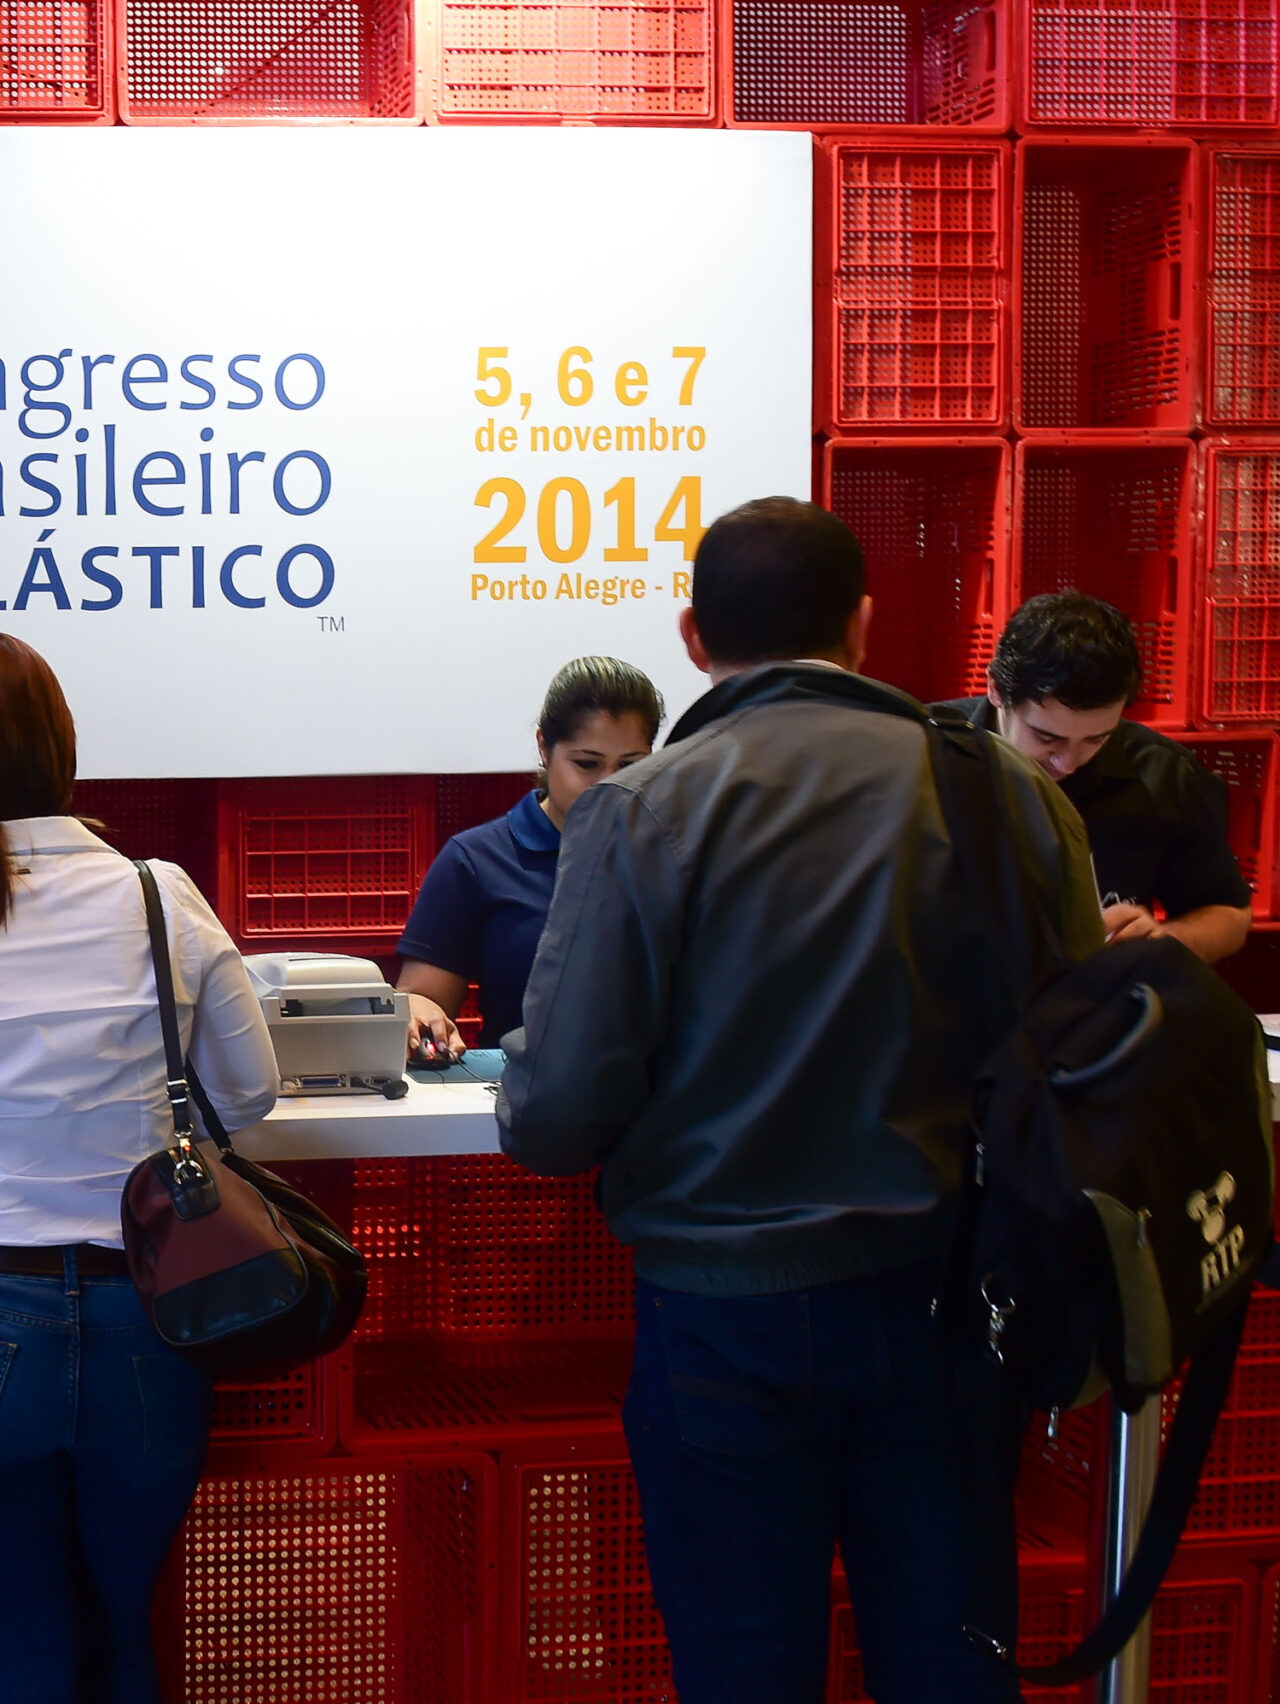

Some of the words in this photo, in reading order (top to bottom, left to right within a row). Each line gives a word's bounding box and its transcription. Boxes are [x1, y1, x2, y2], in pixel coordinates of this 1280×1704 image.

[474, 346, 532, 420] 5,
[557, 346, 594, 406] 6
[615, 361, 649, 406] e
[672, 346, 706, 406] 7
[475, 418, 518, 452] de
[531, 417, 706, 452] novembro
[473, 476, 708, 564] 2014
[471, 573, 548, 601] Porto
[554, 573, 646, 606] Alegre
[673, 571, 693, 599] R
